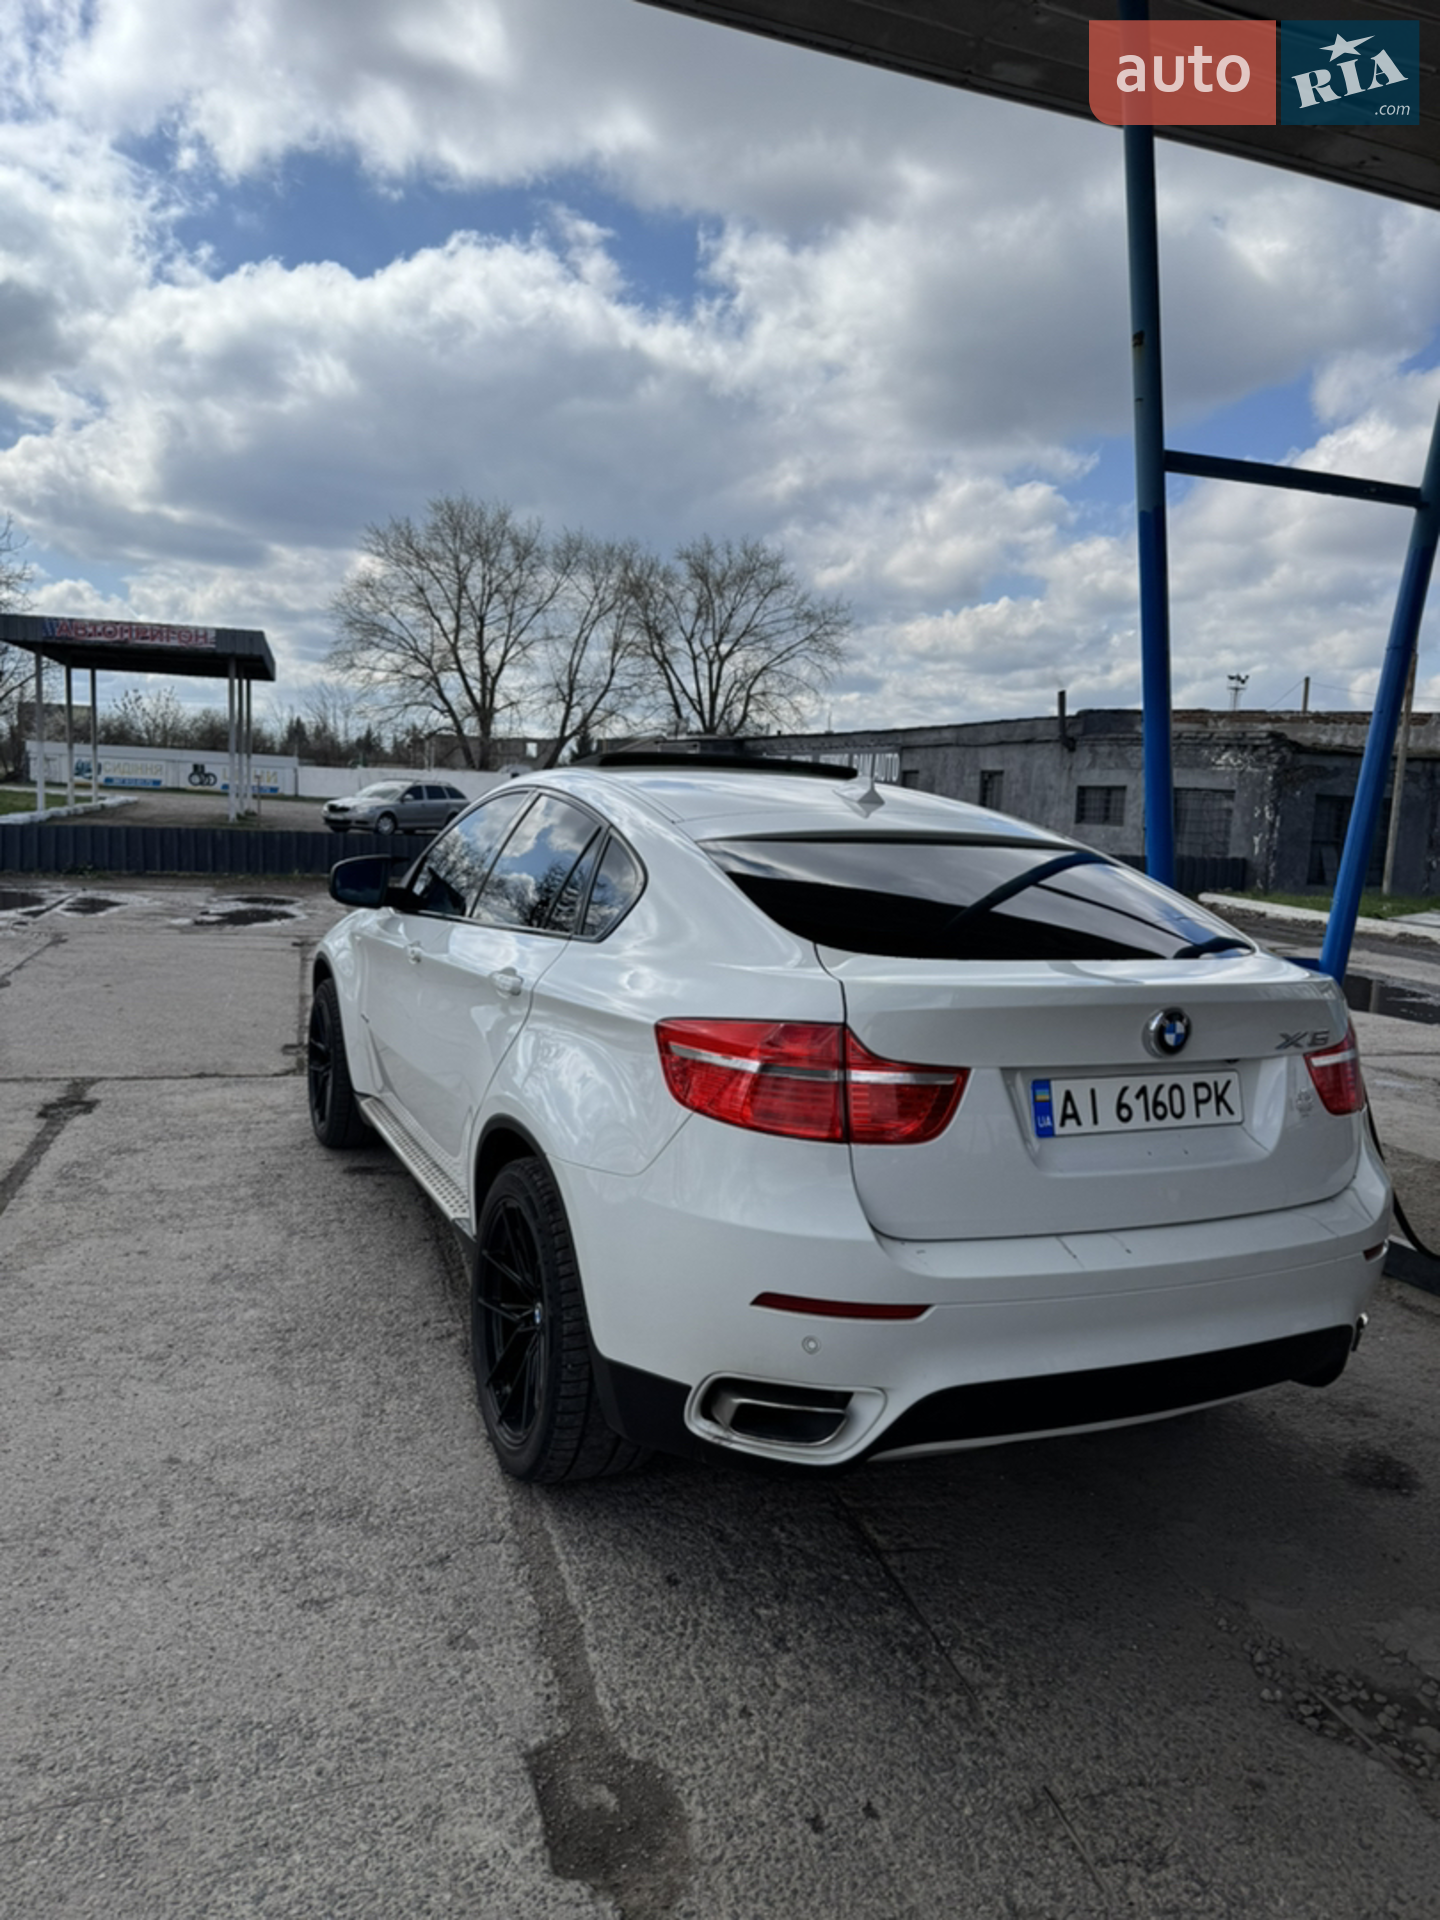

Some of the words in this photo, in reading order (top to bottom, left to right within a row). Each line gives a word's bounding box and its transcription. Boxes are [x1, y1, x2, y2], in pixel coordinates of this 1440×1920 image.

[1275, 1030, 1330, 1050] X6
[1059, 1087, 1099, 1128] AI
[1115, 1083, 1186, 1123] 6160
[1193, 1079, 1235, 1118] PK
